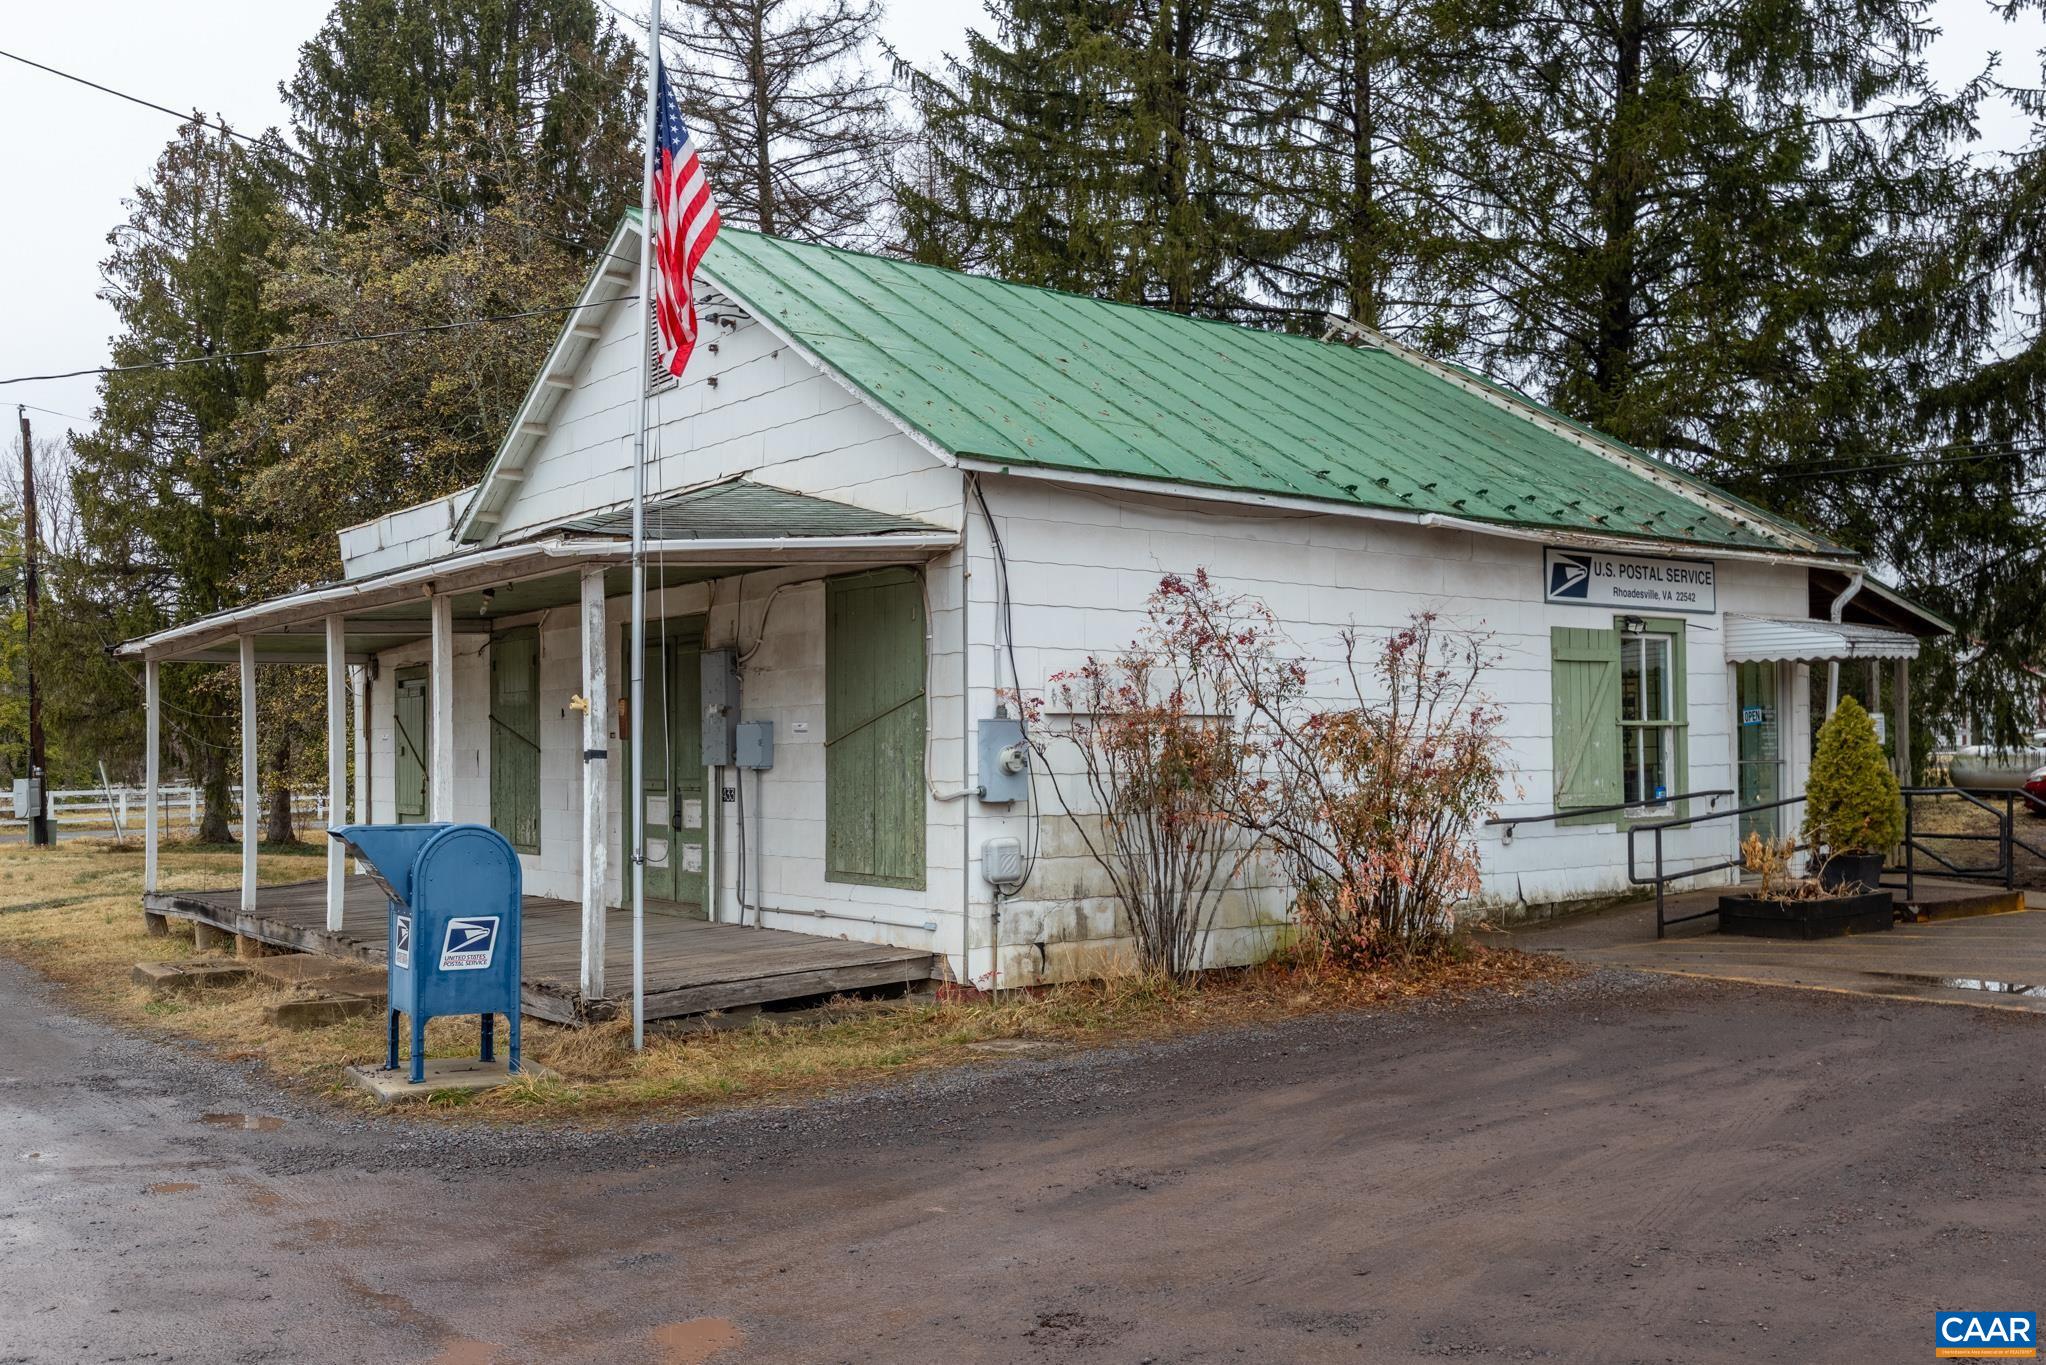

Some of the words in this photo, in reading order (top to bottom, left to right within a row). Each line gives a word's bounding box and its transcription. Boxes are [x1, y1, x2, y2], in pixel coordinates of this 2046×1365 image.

[1594, 561, 1616, 577] U.S.
[1619, 564, 1663, 581] POSTAL
[1666, 568, 1712, 585] SERVICE
[1613, 586, 1661, 601] Rhoadesville,
[1662, 590, 1672, 601] VA
[1676, 592, 1696, 602] 22542
[1745, 710, 1760, 722] OPEN
